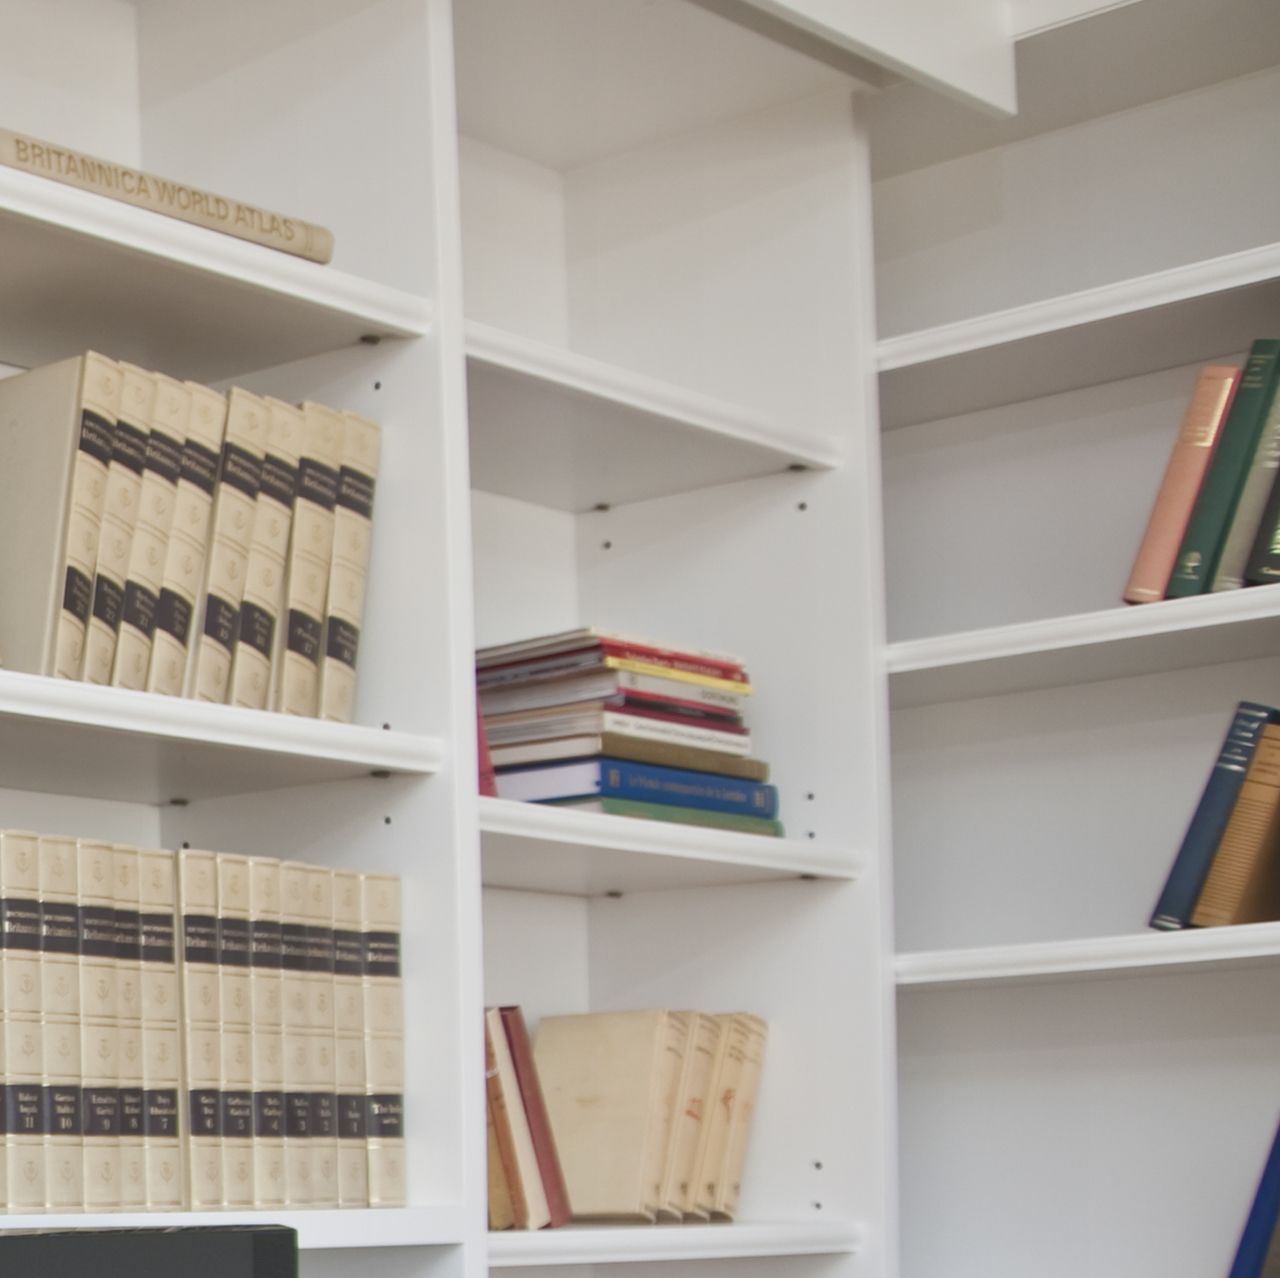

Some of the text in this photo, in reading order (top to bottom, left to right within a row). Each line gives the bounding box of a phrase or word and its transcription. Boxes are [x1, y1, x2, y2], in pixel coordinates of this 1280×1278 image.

[13, 137, 297, 243] BRITANNICA WORLD ATLAS
